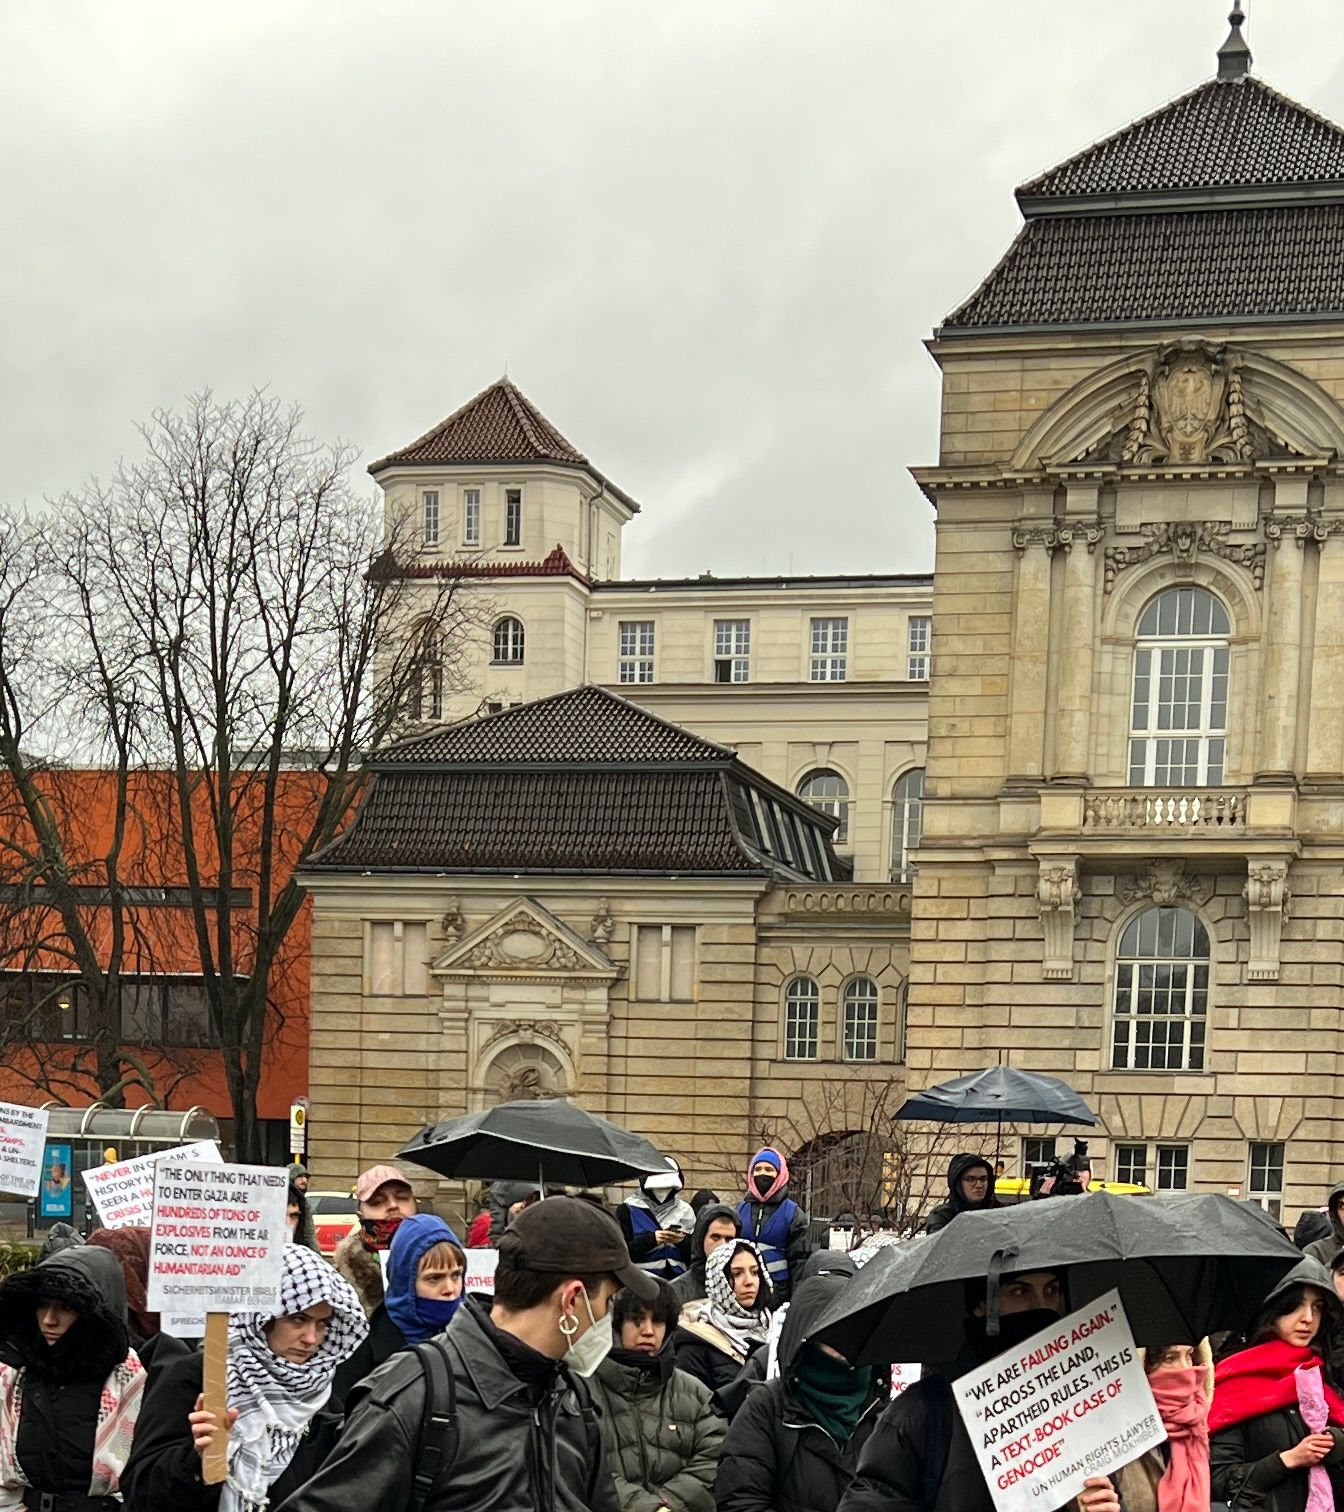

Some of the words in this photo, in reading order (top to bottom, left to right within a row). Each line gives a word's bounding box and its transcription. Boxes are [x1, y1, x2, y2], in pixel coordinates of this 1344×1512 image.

[22, 1111, 35, 1119] THE
[132, 1162, 145, 1172] IN
[94, 1177, 142, 1197] HISTORY
[184, 1169, 208, 1182] ONLY
[210, 1171, 236, 1184] THING
[238, 1173, 262, 1186] THAT
[262, 1175, 286, 1188] NEEDS
[101, 1194, 129, 1209] SEEN
[131, 1192, 140, 1201] A
[158, 1186, 172, 1199] TO
[173, 1187, 202, 1201] ENTER
[203, 1189, 228, 1202] GAZA
[230, 1191, 249, 1203] ARE
[106, 1205, 142, 1221] CRISIS
[157, 1205, 206, 1219] HUNDREDS
[208, 1208, 221, 1220] OF
[222, 1209, 246, 1221] TONS
[247, 1210, 261, 1222] OF
[155, 1224, 211, 1239] EXPLOSIVES
[213, 1226, 238, 1240] FROM
[239, 1228, 256, 1240] THE
[191, 1244, 209, 1256] NOT
[210, 1245, 224, 1257] AN
[225, 1246, 257, 1258] OUNCE
[258, 1247, 268, 1258] OF
[153, 1262, 224, 1276] HUMANITARIAN
[965, 1378, 995, 1403] “WE
[997, 1363, 1021, 1389] ARE
[1020, 1335, 1069, 1373] FAILING
[1071, 1304, 1118, 1345] AGAIN.”
[976, 1381, 1036, 1422] “ACROSS
[1036, 1365, 1061, 1390] THE
[1061, 1345, 1100, 1375] LAND,
[983, 1398, 1050, 1449] APARTHEID
[1050, 1373, 1094, 1406] RULES.
[1092, 1357, 1120, 1382] THIS
[1119, 1348, 1133, 1365] IS
[990, 1454, 1002, 1470] A
[1001, 1409, 1074, 1462] TEXT-BOOK
[1073, 1393, 1107, 1419] CASE
[1106, 1378, 1124, 1398] OF
[1032, 1483, 1049, 1497] UN
[1048, 1459, 1086, 1486] HUMAN
[1085, 1439, 1119, 1465] RIGHTS
[1119, 1414, 1156, 1443] LAWYER
[1083, 1455, 1113, 1477] CRAIG
[1112, 1424, 1160, 1460] MOKHIBER
[997, 1438, 1066, 1490] GENOCIDE”
